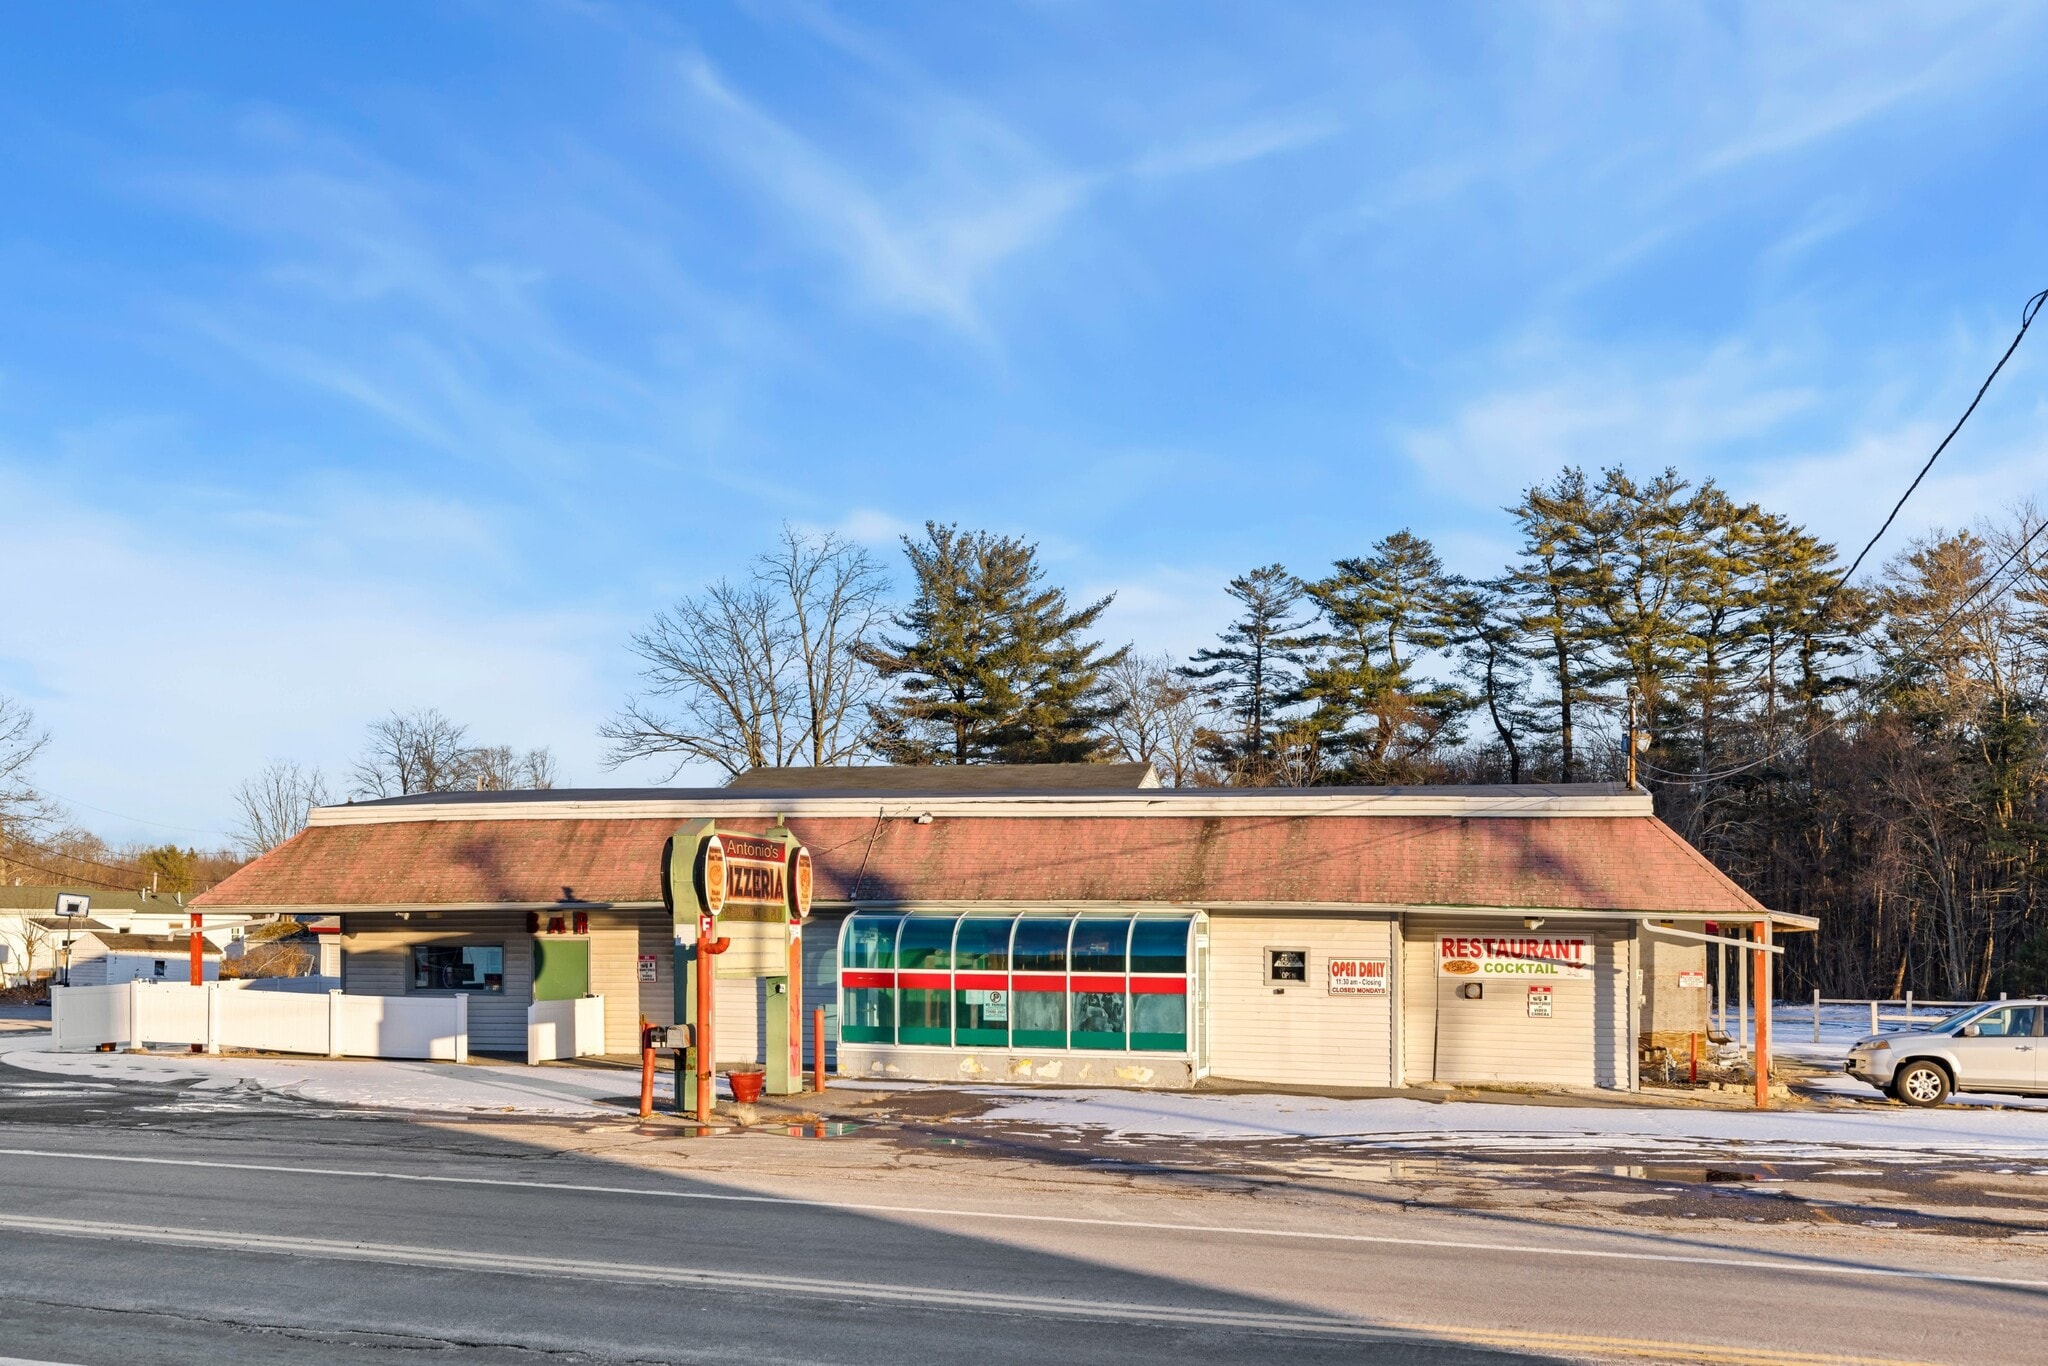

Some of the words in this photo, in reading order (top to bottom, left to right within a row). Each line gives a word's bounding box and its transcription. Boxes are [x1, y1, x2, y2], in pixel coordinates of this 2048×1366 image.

[727, 839, 779, 859] Antonio's
[727, 864, 784, 899] IZZERIA
[526, 911, 589, 935] BAR
[1441, 937, 1585, 960] RESTAURANT
[1331, 961, 1356, 978] OPEN
[1358, 961, 1386, 978] DAILY
[1484, 962, 1559, 975] COCKTAIL
[1361, 978, 1382, 987] Closing
